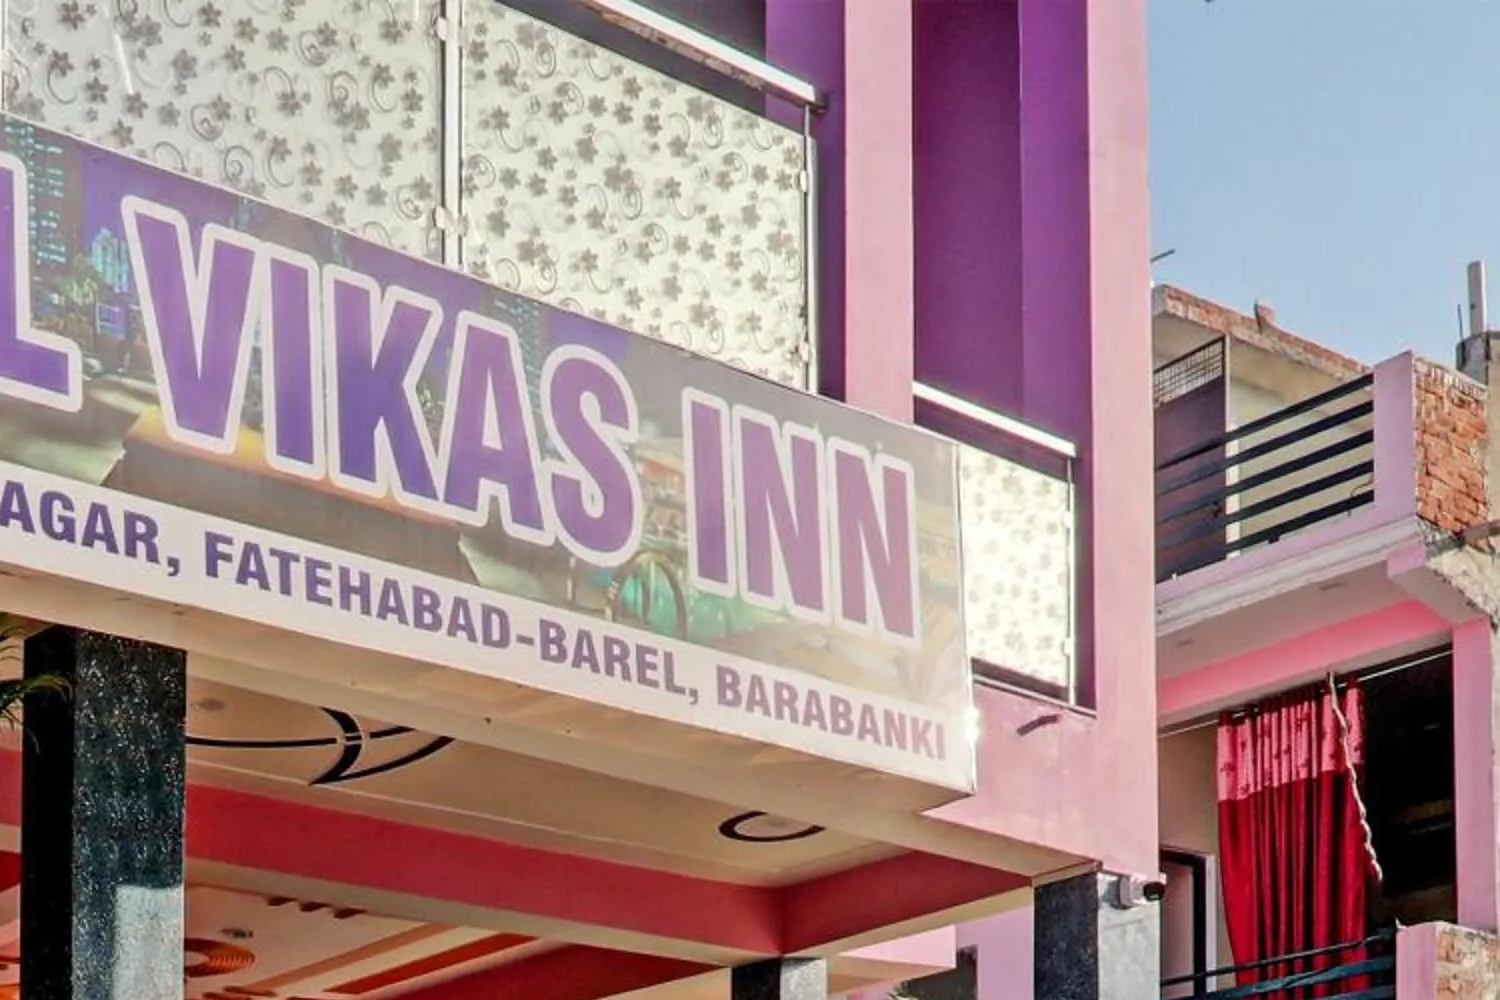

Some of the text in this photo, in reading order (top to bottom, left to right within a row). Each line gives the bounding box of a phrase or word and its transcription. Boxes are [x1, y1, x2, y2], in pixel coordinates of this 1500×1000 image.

[120, 196, 642, 567] VIKAS
[682, 388, 920, 649] INN
[204, 531, 699, 705] FATEHABAD-BAREL,
[717, 666, 946, 760] BARABANKI
